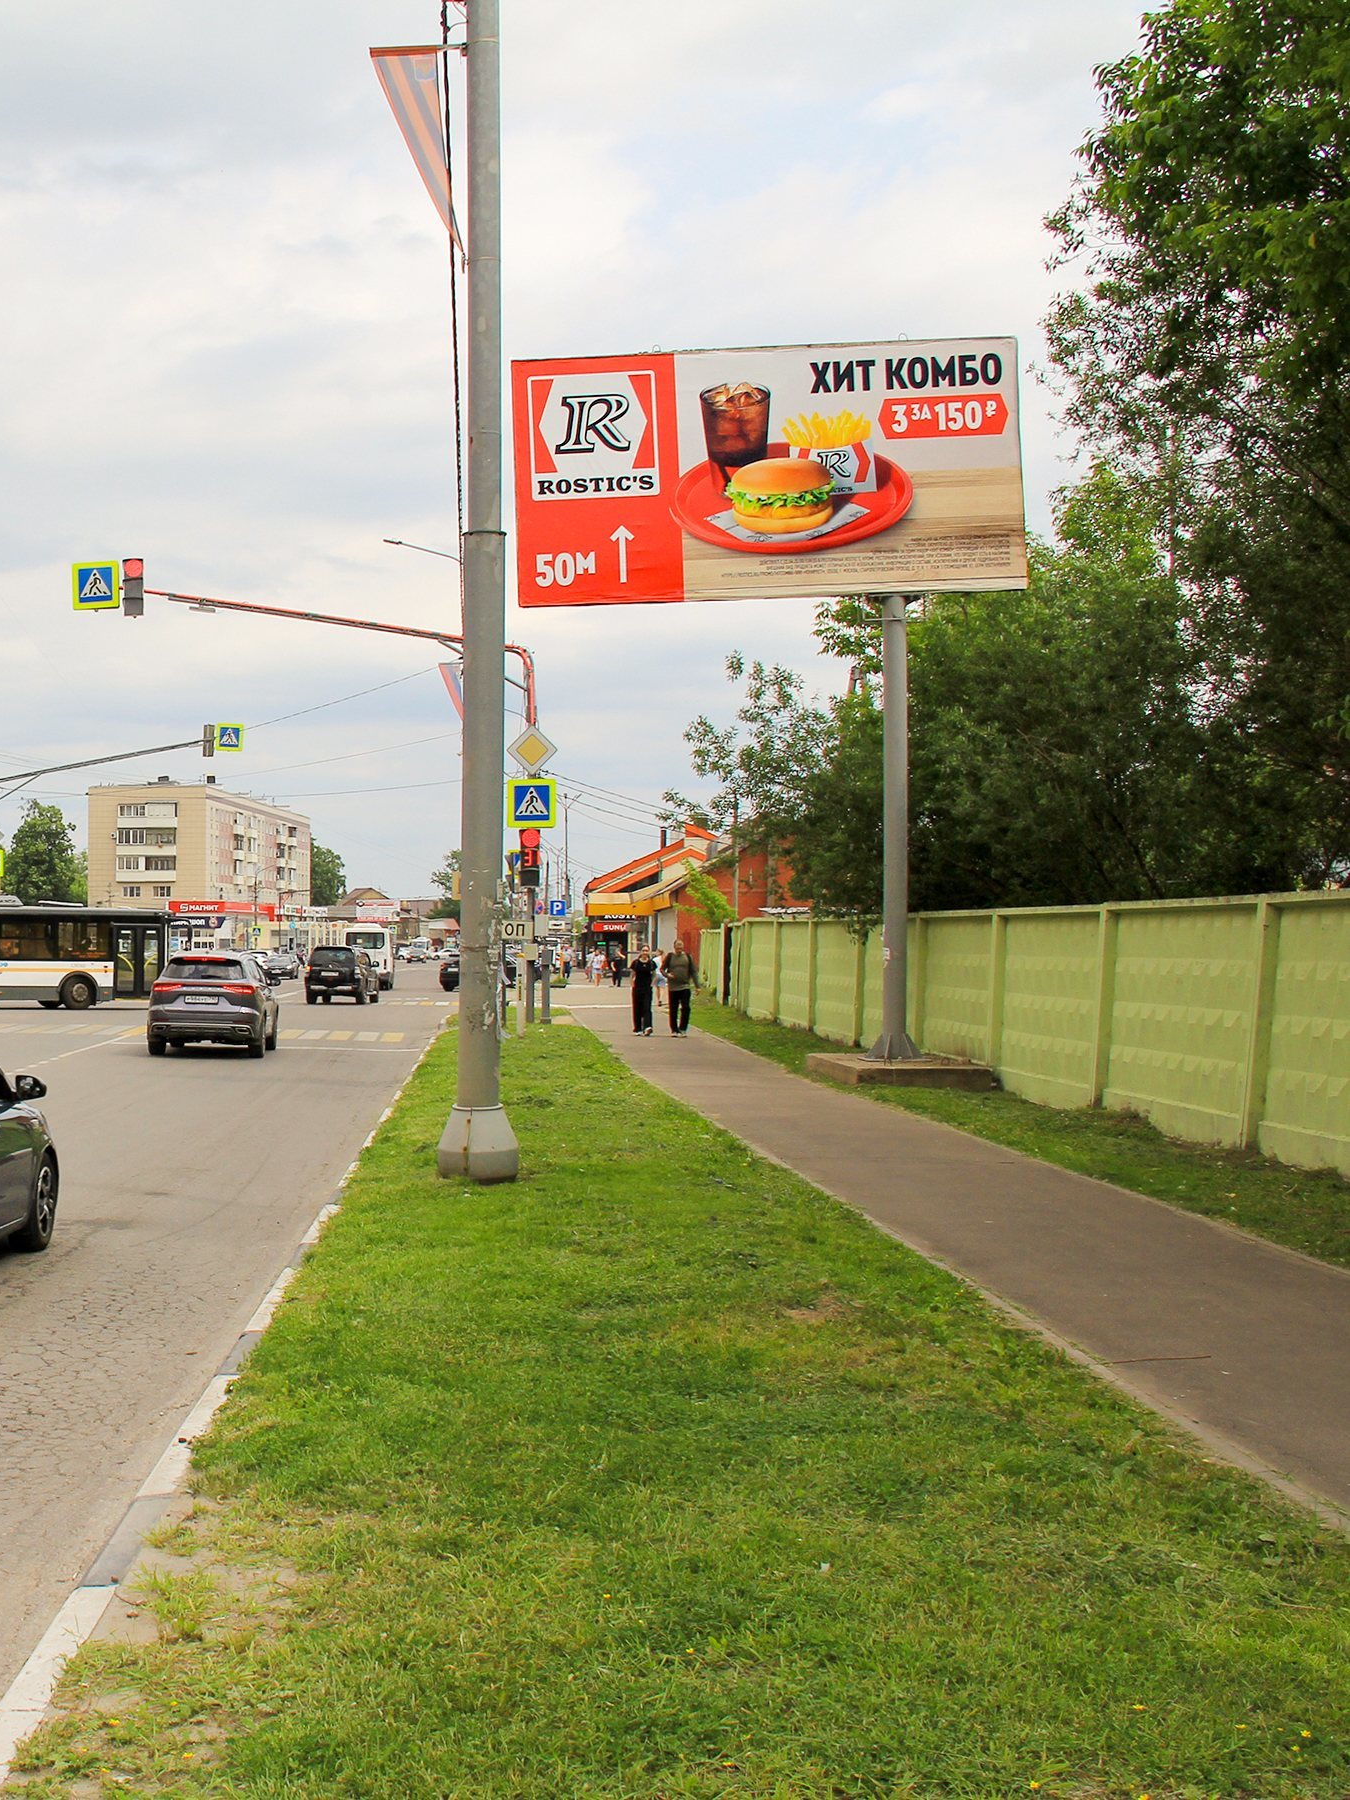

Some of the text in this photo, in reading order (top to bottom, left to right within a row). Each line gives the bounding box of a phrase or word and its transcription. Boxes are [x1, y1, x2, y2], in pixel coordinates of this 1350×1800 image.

[810, 353, 1002, 394] ХИТ КОМБО
[891, 404, 908, 433] 3
[537, 475, 654, 495] ROSTIC'S
[505, 923, 525, 936] ОП
